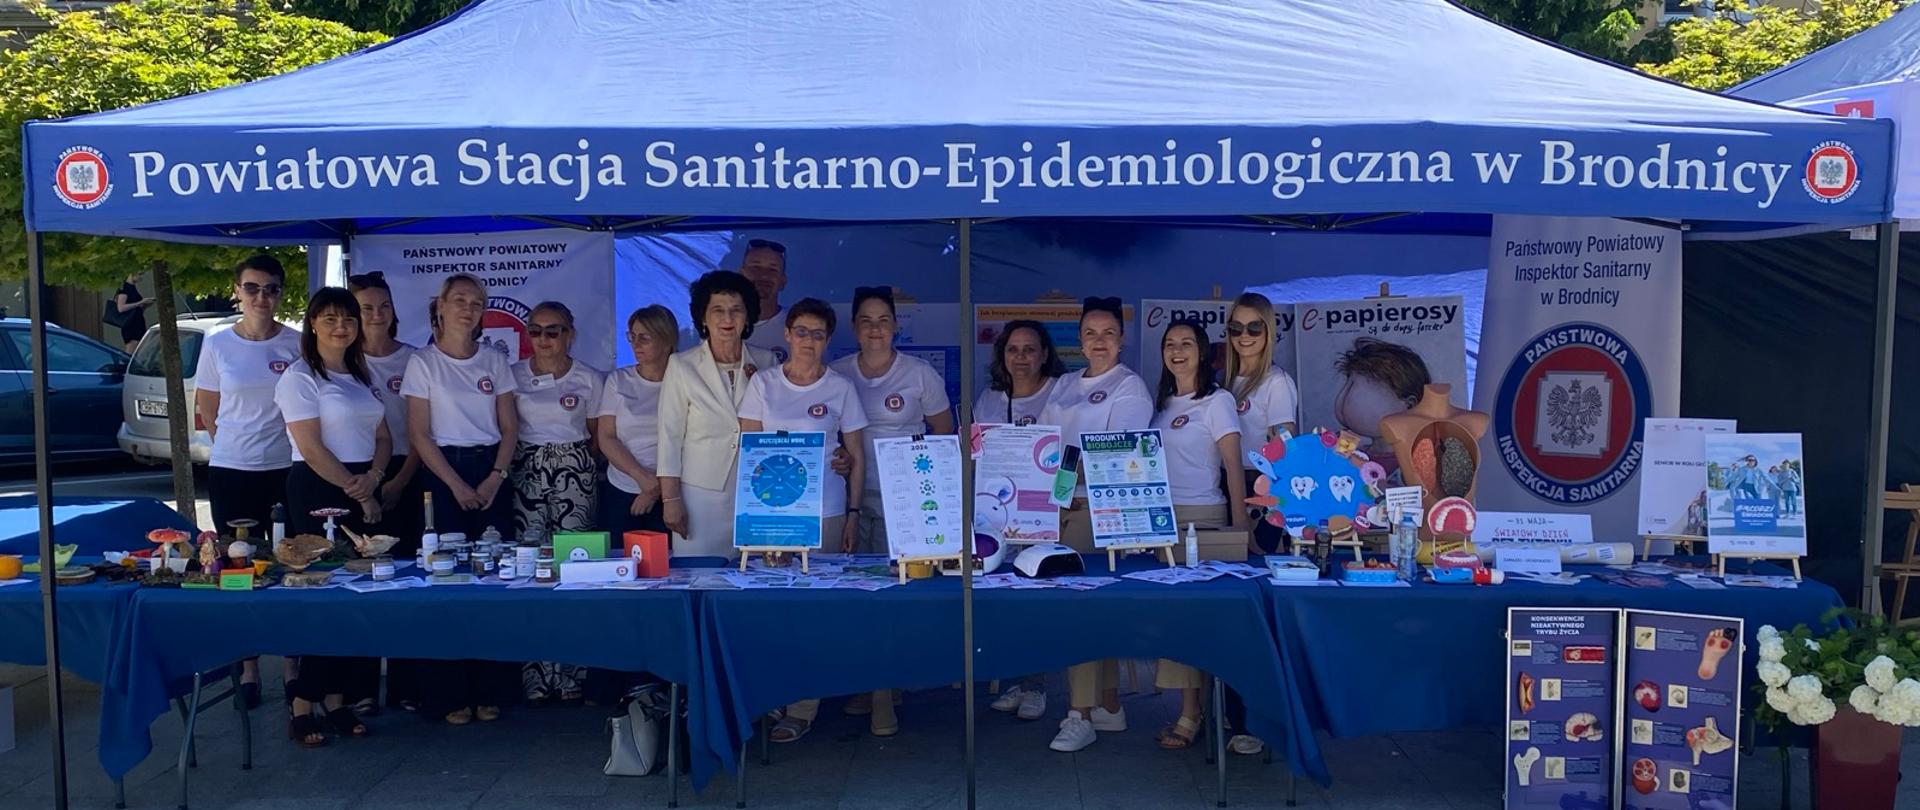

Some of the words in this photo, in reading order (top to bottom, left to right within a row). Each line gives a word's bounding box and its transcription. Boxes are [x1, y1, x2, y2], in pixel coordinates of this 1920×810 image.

[128, 144, 439, 198] Powiatowa
[457, 137, 626, 202] Stacja
[645, 136, 1454, 203] Sanitarno-Epidemiologiczna
[1471, 152, 1522, 184] w
[1540, 140, 1792, 209] Brodnicy
[403, 246, 485, 259] PAŃSTWOWY
[489, 243, 567, 255] POWIATOWY
[1505, 239, 1583, 257] Państwowy
[1587, 234, 1664, 254] Powiatowy
[412, 262, 486, 274] INSPEKTOR
[490, 259, 563, 272] SANITARNY
[1515, 264, 1579, 284] Inspektor
[1583, 261, 1651, 281] Sanitarny
[481, 276, 528, 287] ODNICY
[1541, 291, 1554, 305] w
[1558, 287, 1620, 307] Brodnicy
[1302, 303, 1458, 331] e-papierosy
[1525, 328, 1628, 365] PAŃSTWOWA
[1085, 433, 1126, 442] PRODUKTY
[1499, 434, 1565, 501] INSPEKCJA
[1569, 440, 1645, 502] SANITARNA
